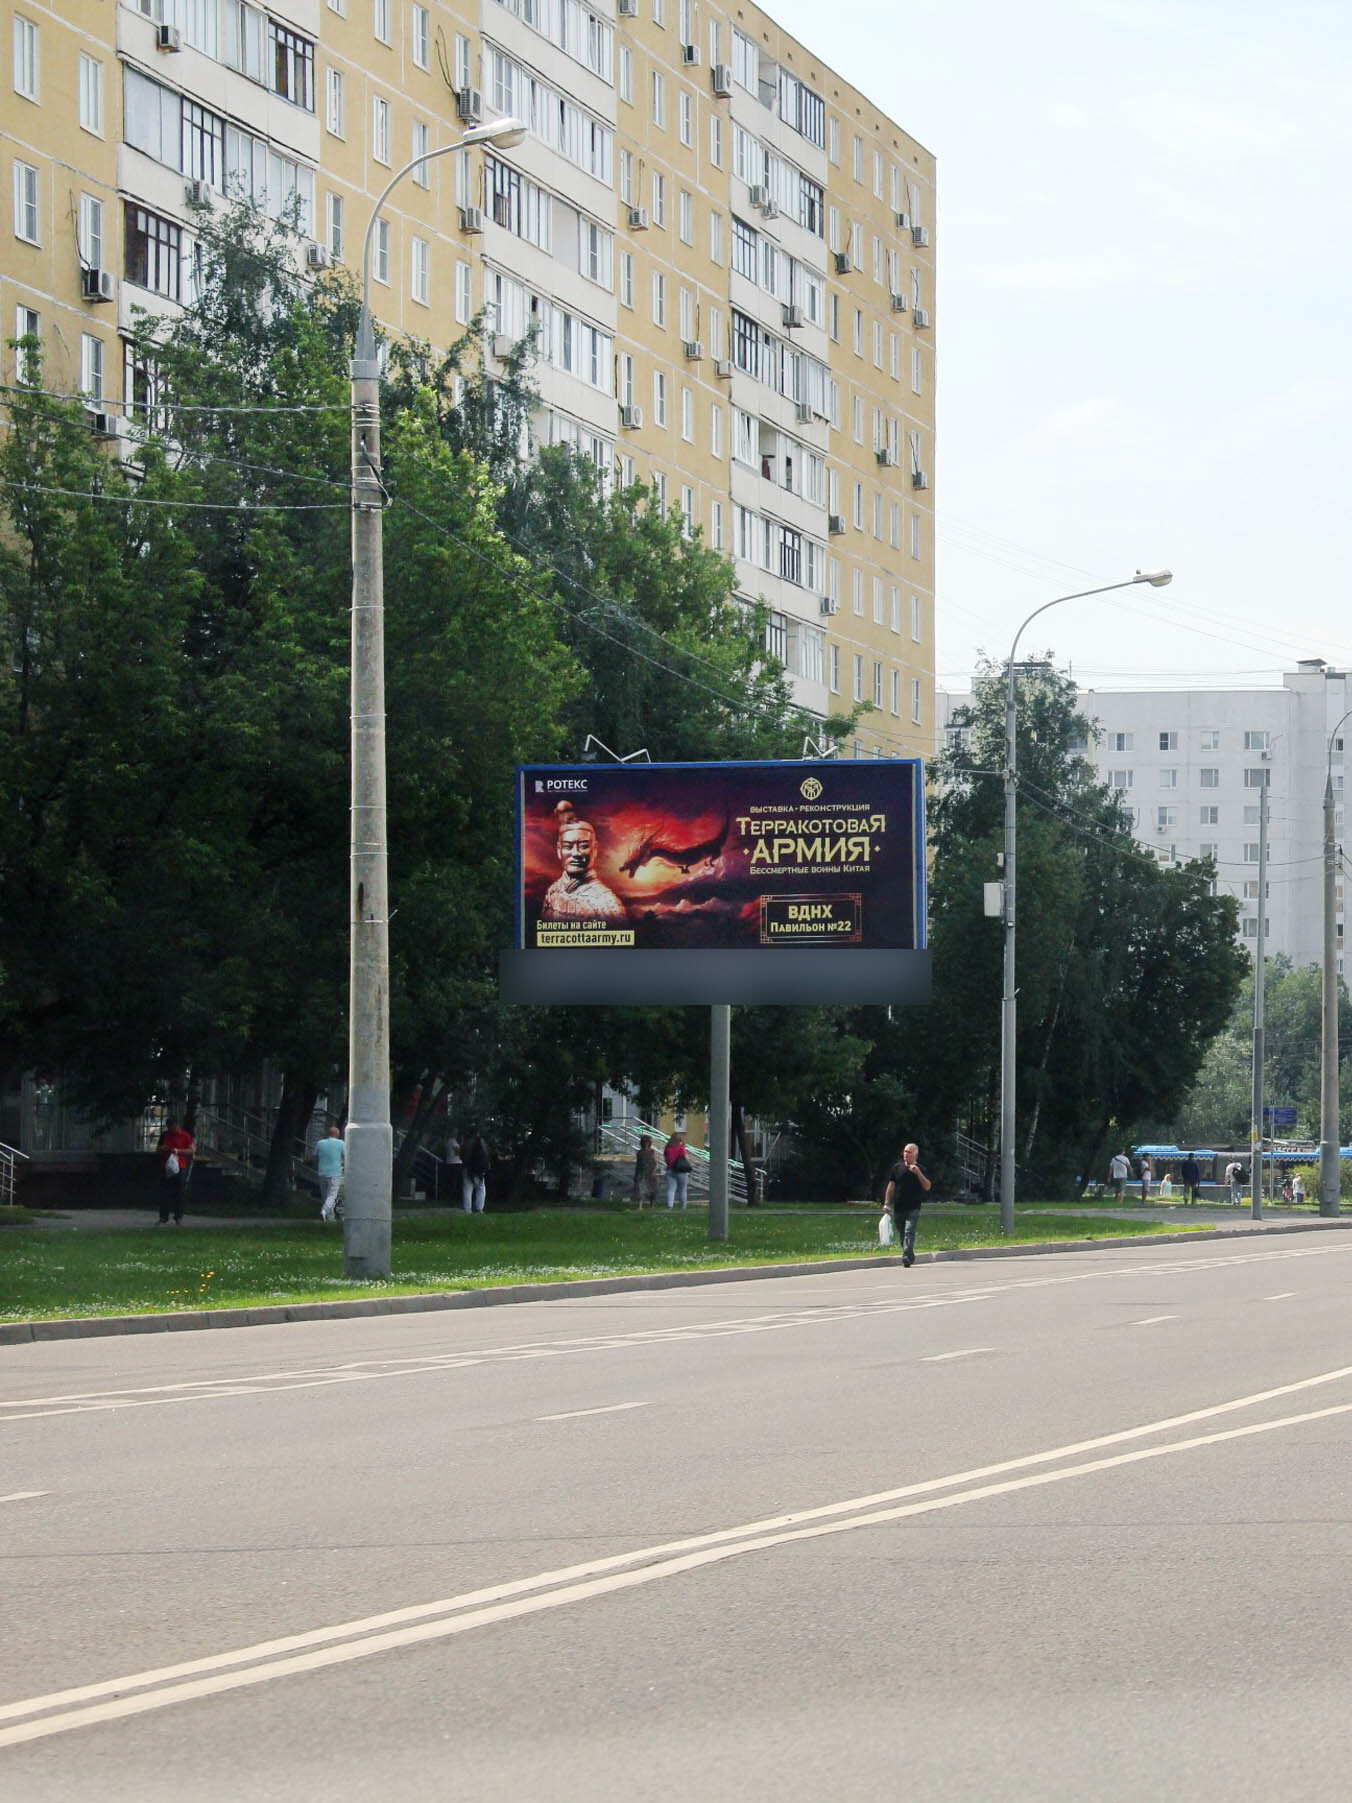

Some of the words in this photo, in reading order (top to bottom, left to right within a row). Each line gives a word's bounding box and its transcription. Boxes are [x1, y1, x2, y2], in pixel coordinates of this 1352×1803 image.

[547, 779, 588, 789] РОТЕКС
[735, 814, 886, 835] ТЕРРАКОТОВАЯ
[751, 837, 871, 864] АРМИЯ
[788, 904, 833, 921] ВДНХ
[537, 920, 569, 930] Билеты
[570, 921, 581, 930] на
[582, 920, 607, 930] сайте
[770, 921, 825, 933] ПАВИЛЬОН
[541, 932, 631, 945] terracottaarmy.ru
